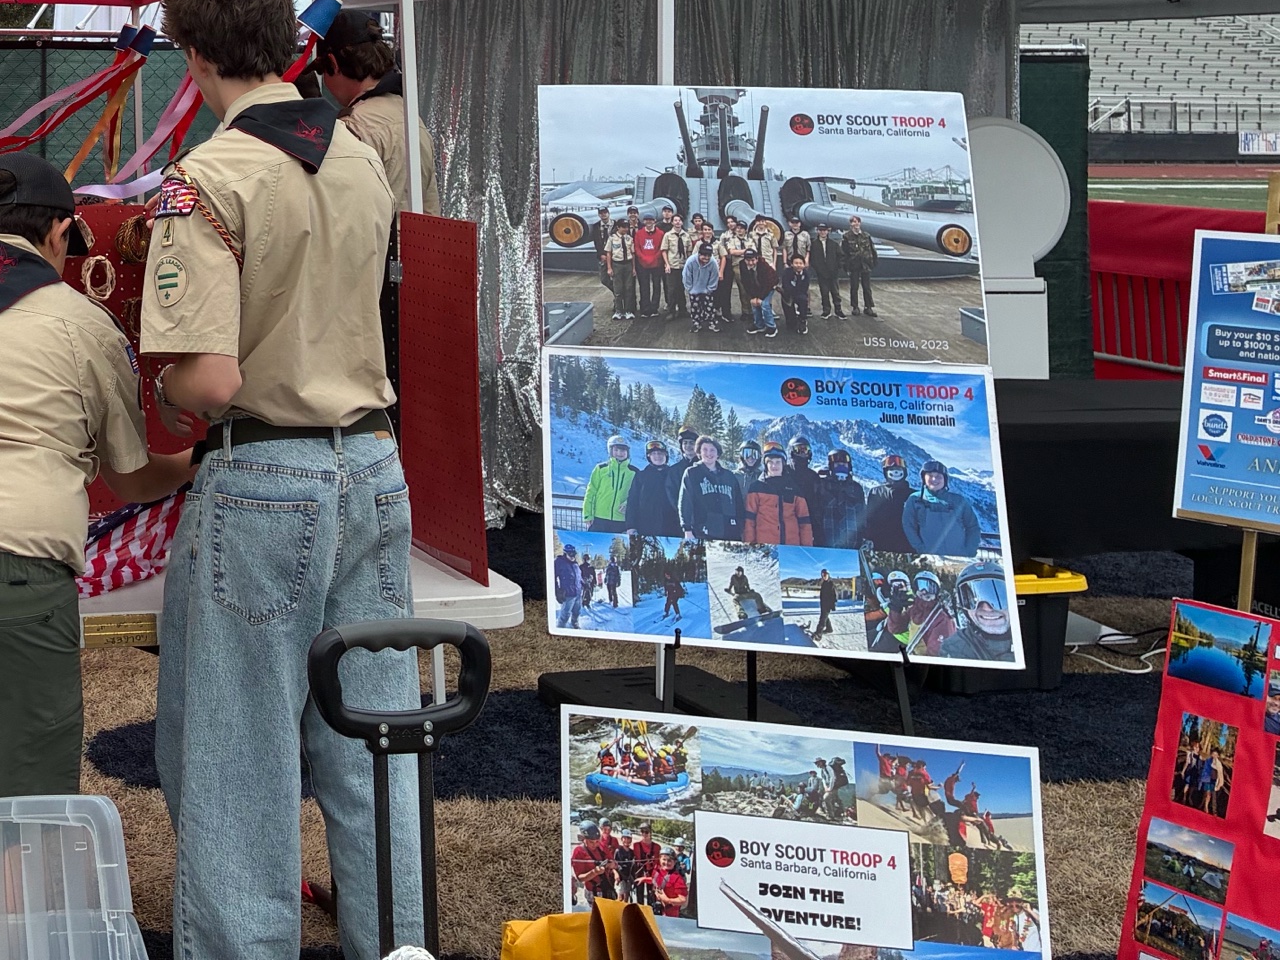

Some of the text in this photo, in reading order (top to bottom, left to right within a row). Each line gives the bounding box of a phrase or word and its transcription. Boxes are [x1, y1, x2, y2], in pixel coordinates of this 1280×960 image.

[817, 114, 946, 128] BOY SCOUT TROOP 4
[818, 127, 930, 137] Santa Barbara, California
[1215, 329, 1232, 338] Buy
[1256, 333, 1271, 341] $10
[864, 337, 949, 350] USS Iowa, 2023
[1244, 340, 1271, 351] $100's
[1208, 369, 1265, 382] Smart&Final
[815, 380, 974, 401] BOY SCOUT TROOP 4
[816, 396, 954, 412] Santa Barbara, California
[880, 412, 956, 427] June Mountain
[1196, 460, 1225, 469] Valvoline
[1248, 457, 1280, 475] AN
[1191, 494, 1225, 505] LOCAL
[1228, 499, 1261, 510] SCOUT
[1209, 486, 1280, 503] SUPPORT YOU
[740, 840, 897, 870] BOY SCOUT TROOP 4
[740, 858, 877, 881] Santa Barbara, California
[758, 882, 845, 904] JOIN THE
[760, 907, 861, 930] DVENTURE!
